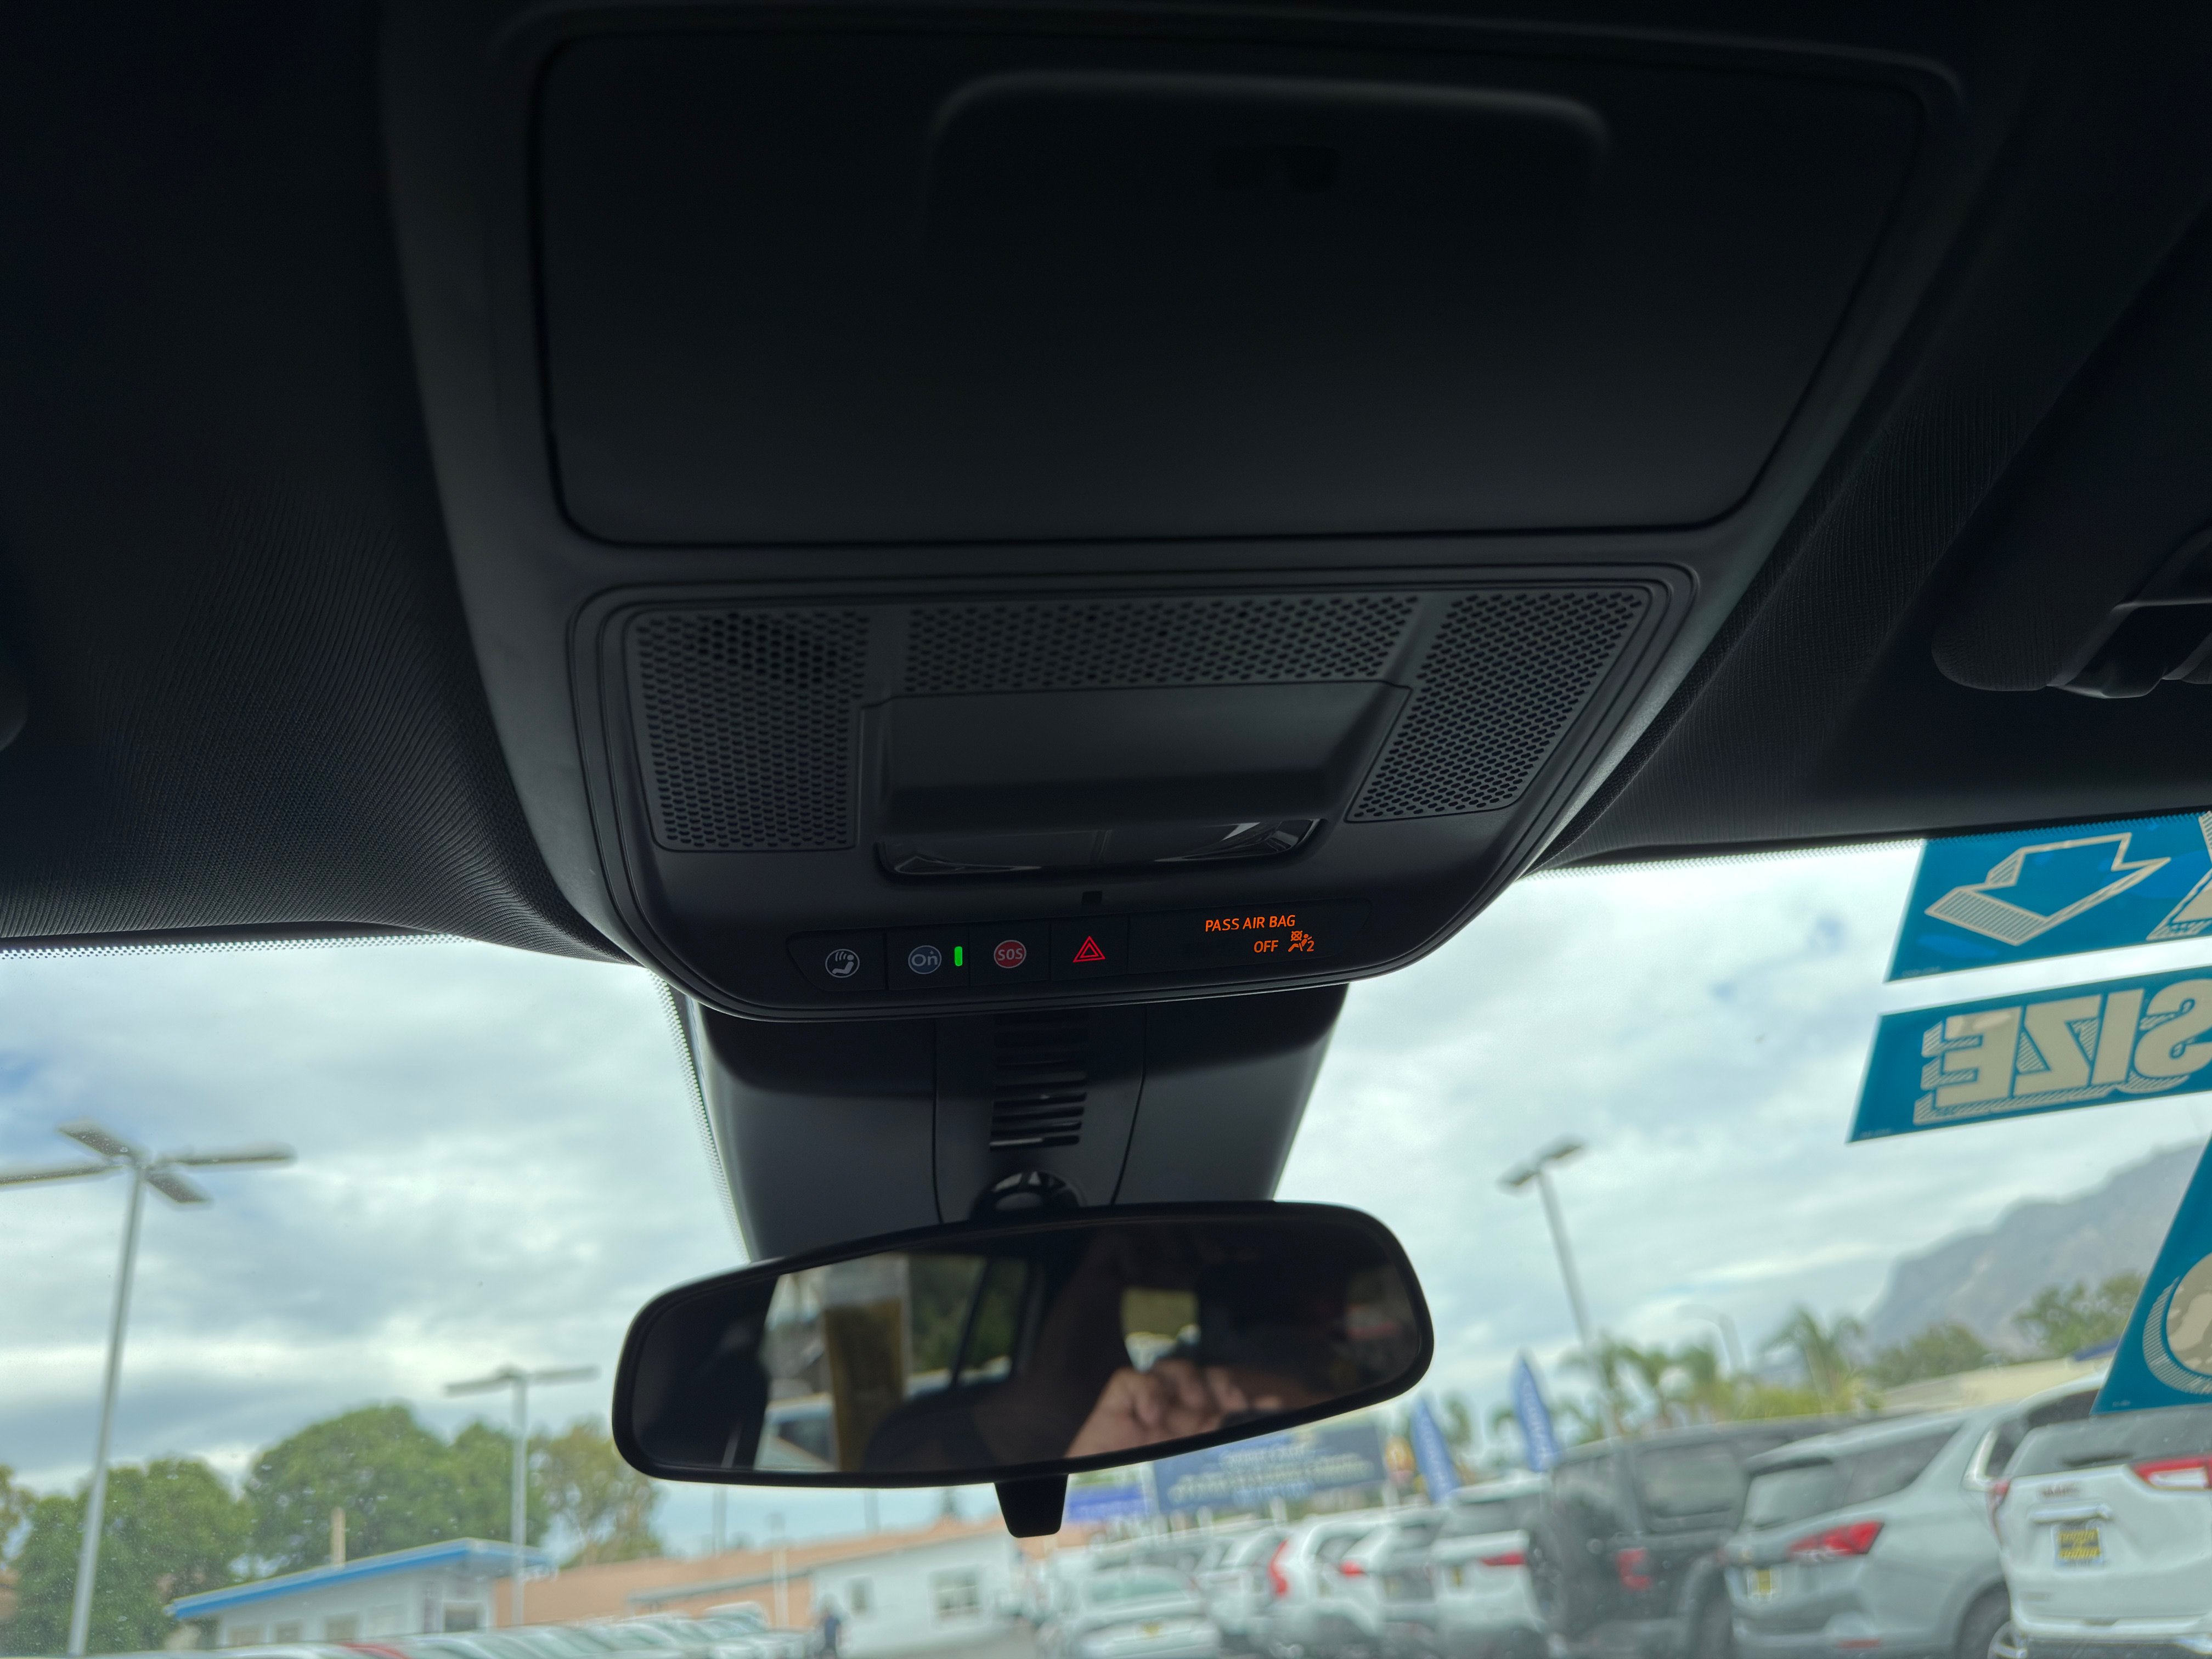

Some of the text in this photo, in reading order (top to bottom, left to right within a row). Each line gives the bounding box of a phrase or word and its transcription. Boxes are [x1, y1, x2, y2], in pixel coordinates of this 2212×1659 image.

[1205, 915, 1295, 932] PASS AIR BAG
[1254, 940, 1279, 953] OFF
[1307, 940, 1314, 952] 2
[911, 952, 938, 967] On
[997, 948, 1023, 961] SOS
